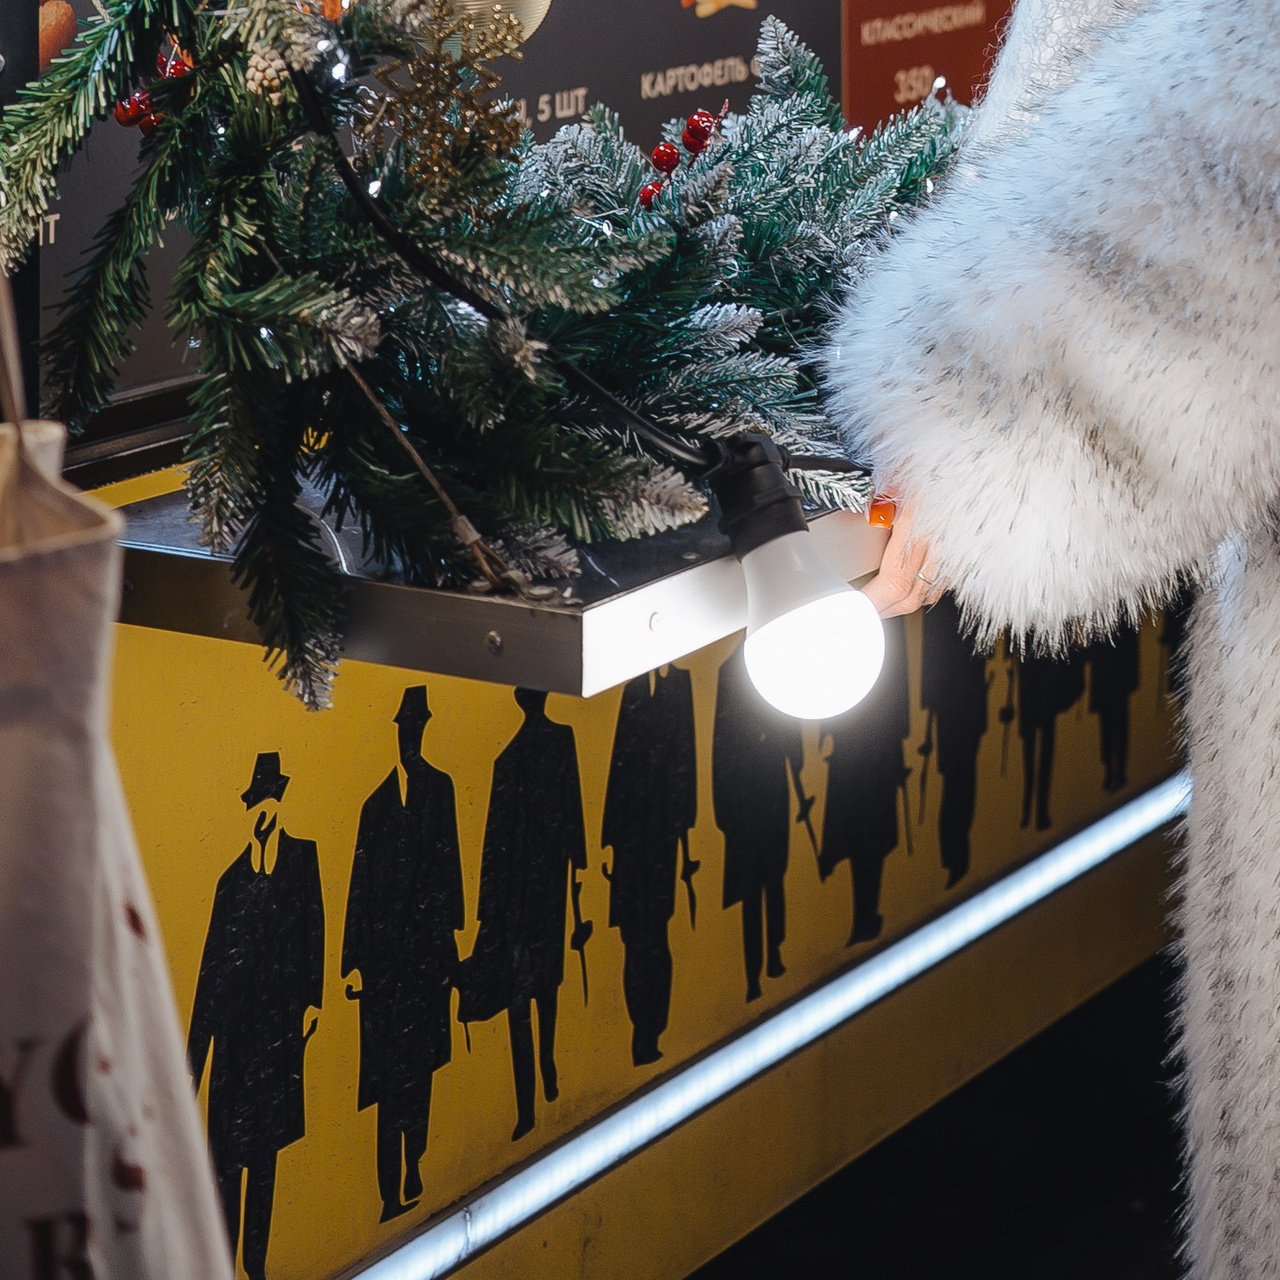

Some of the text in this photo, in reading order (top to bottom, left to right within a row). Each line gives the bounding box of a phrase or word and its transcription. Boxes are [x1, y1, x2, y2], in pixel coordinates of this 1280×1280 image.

[640, 55, 749, 100] КАРТОФЕЛЬ
[893, 64, 935, 104] 350
[536, 93, 553, 124] 5
[554, 85, 588, 120] ШТ
